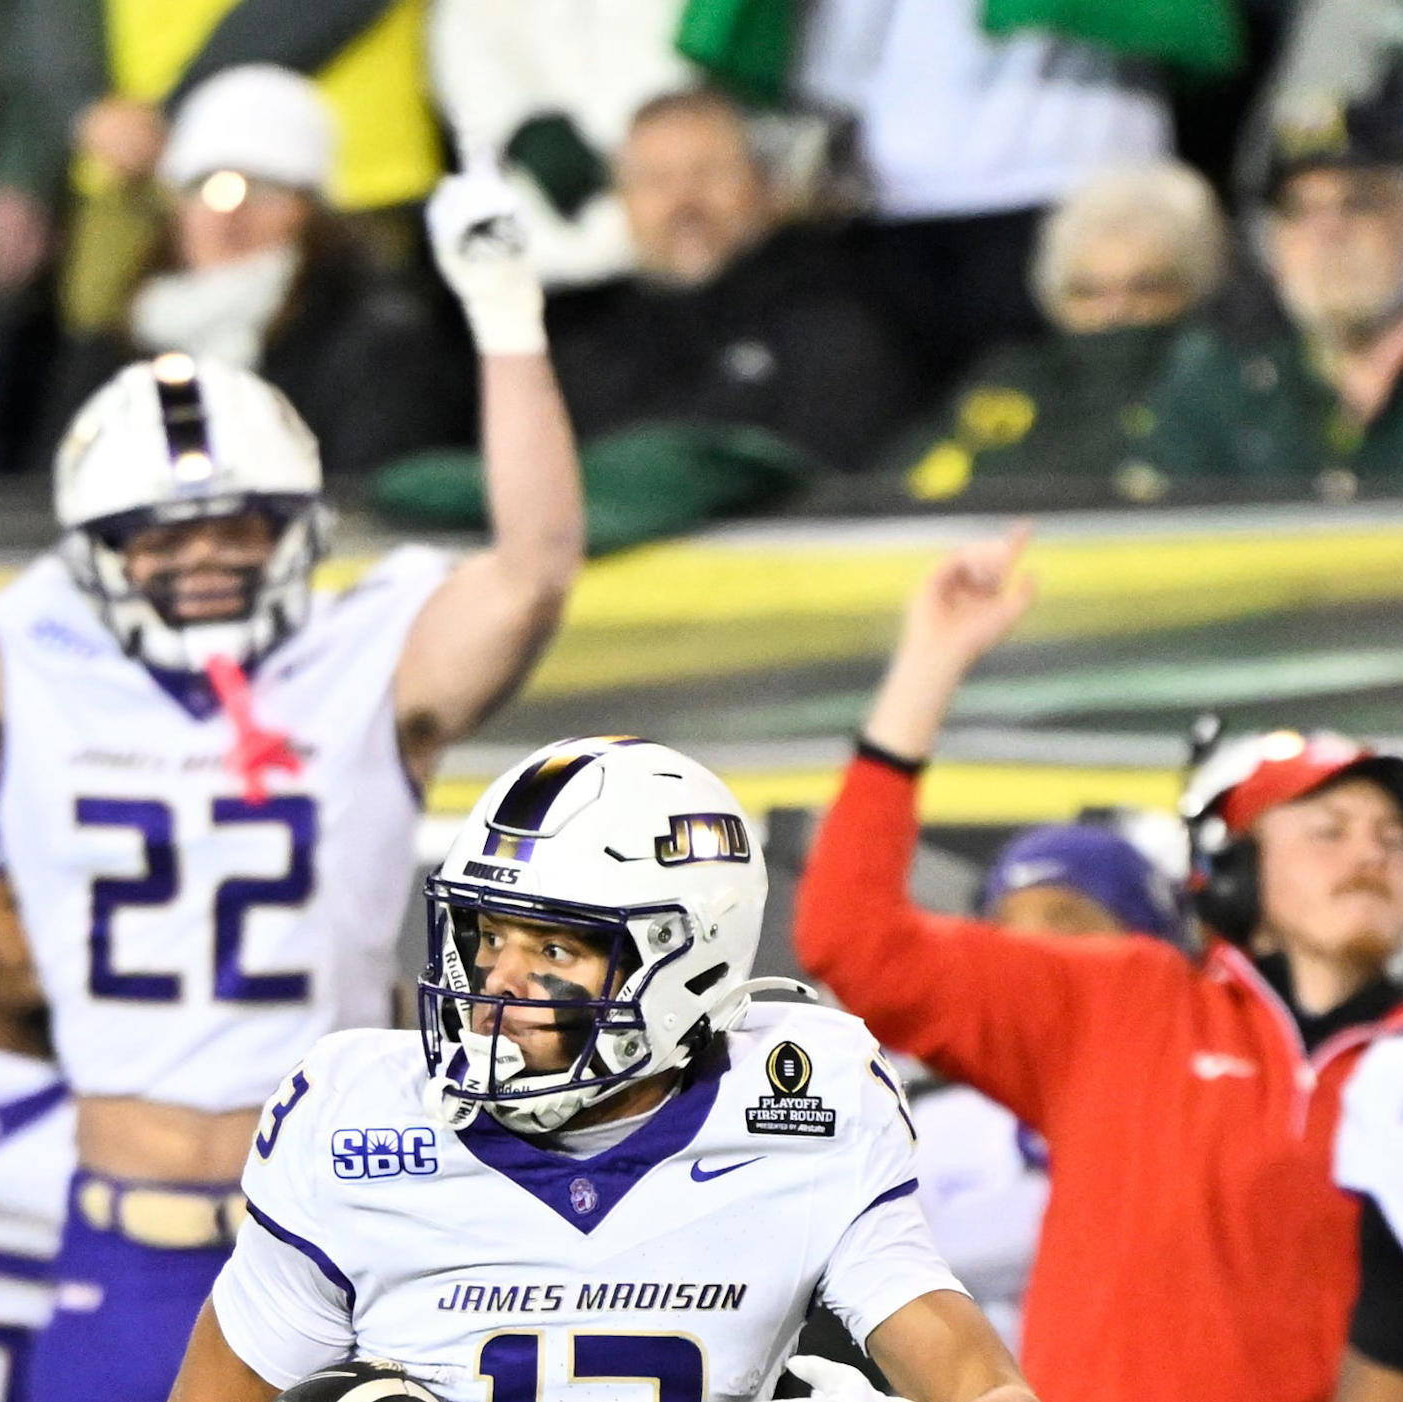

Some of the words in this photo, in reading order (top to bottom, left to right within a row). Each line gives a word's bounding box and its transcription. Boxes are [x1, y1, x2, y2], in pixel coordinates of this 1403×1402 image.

[656, 813, 750, 866] JMU
[462, 860, 521, 884] DUKES
[73, 792, 320, 1004] 22
[445, 950, 471, 1012] Riddll
[748, 1109, 788, 1121] FIRST
[789, 1110, 834, 1123] ROUND
[761, 1097, 820, 1110] PLAYOFF
[331, 1127, 438, 1180] SBC
[437, 1283, 566, 1312] JAMES
[576, 1282, 748, 1312] MADISON
